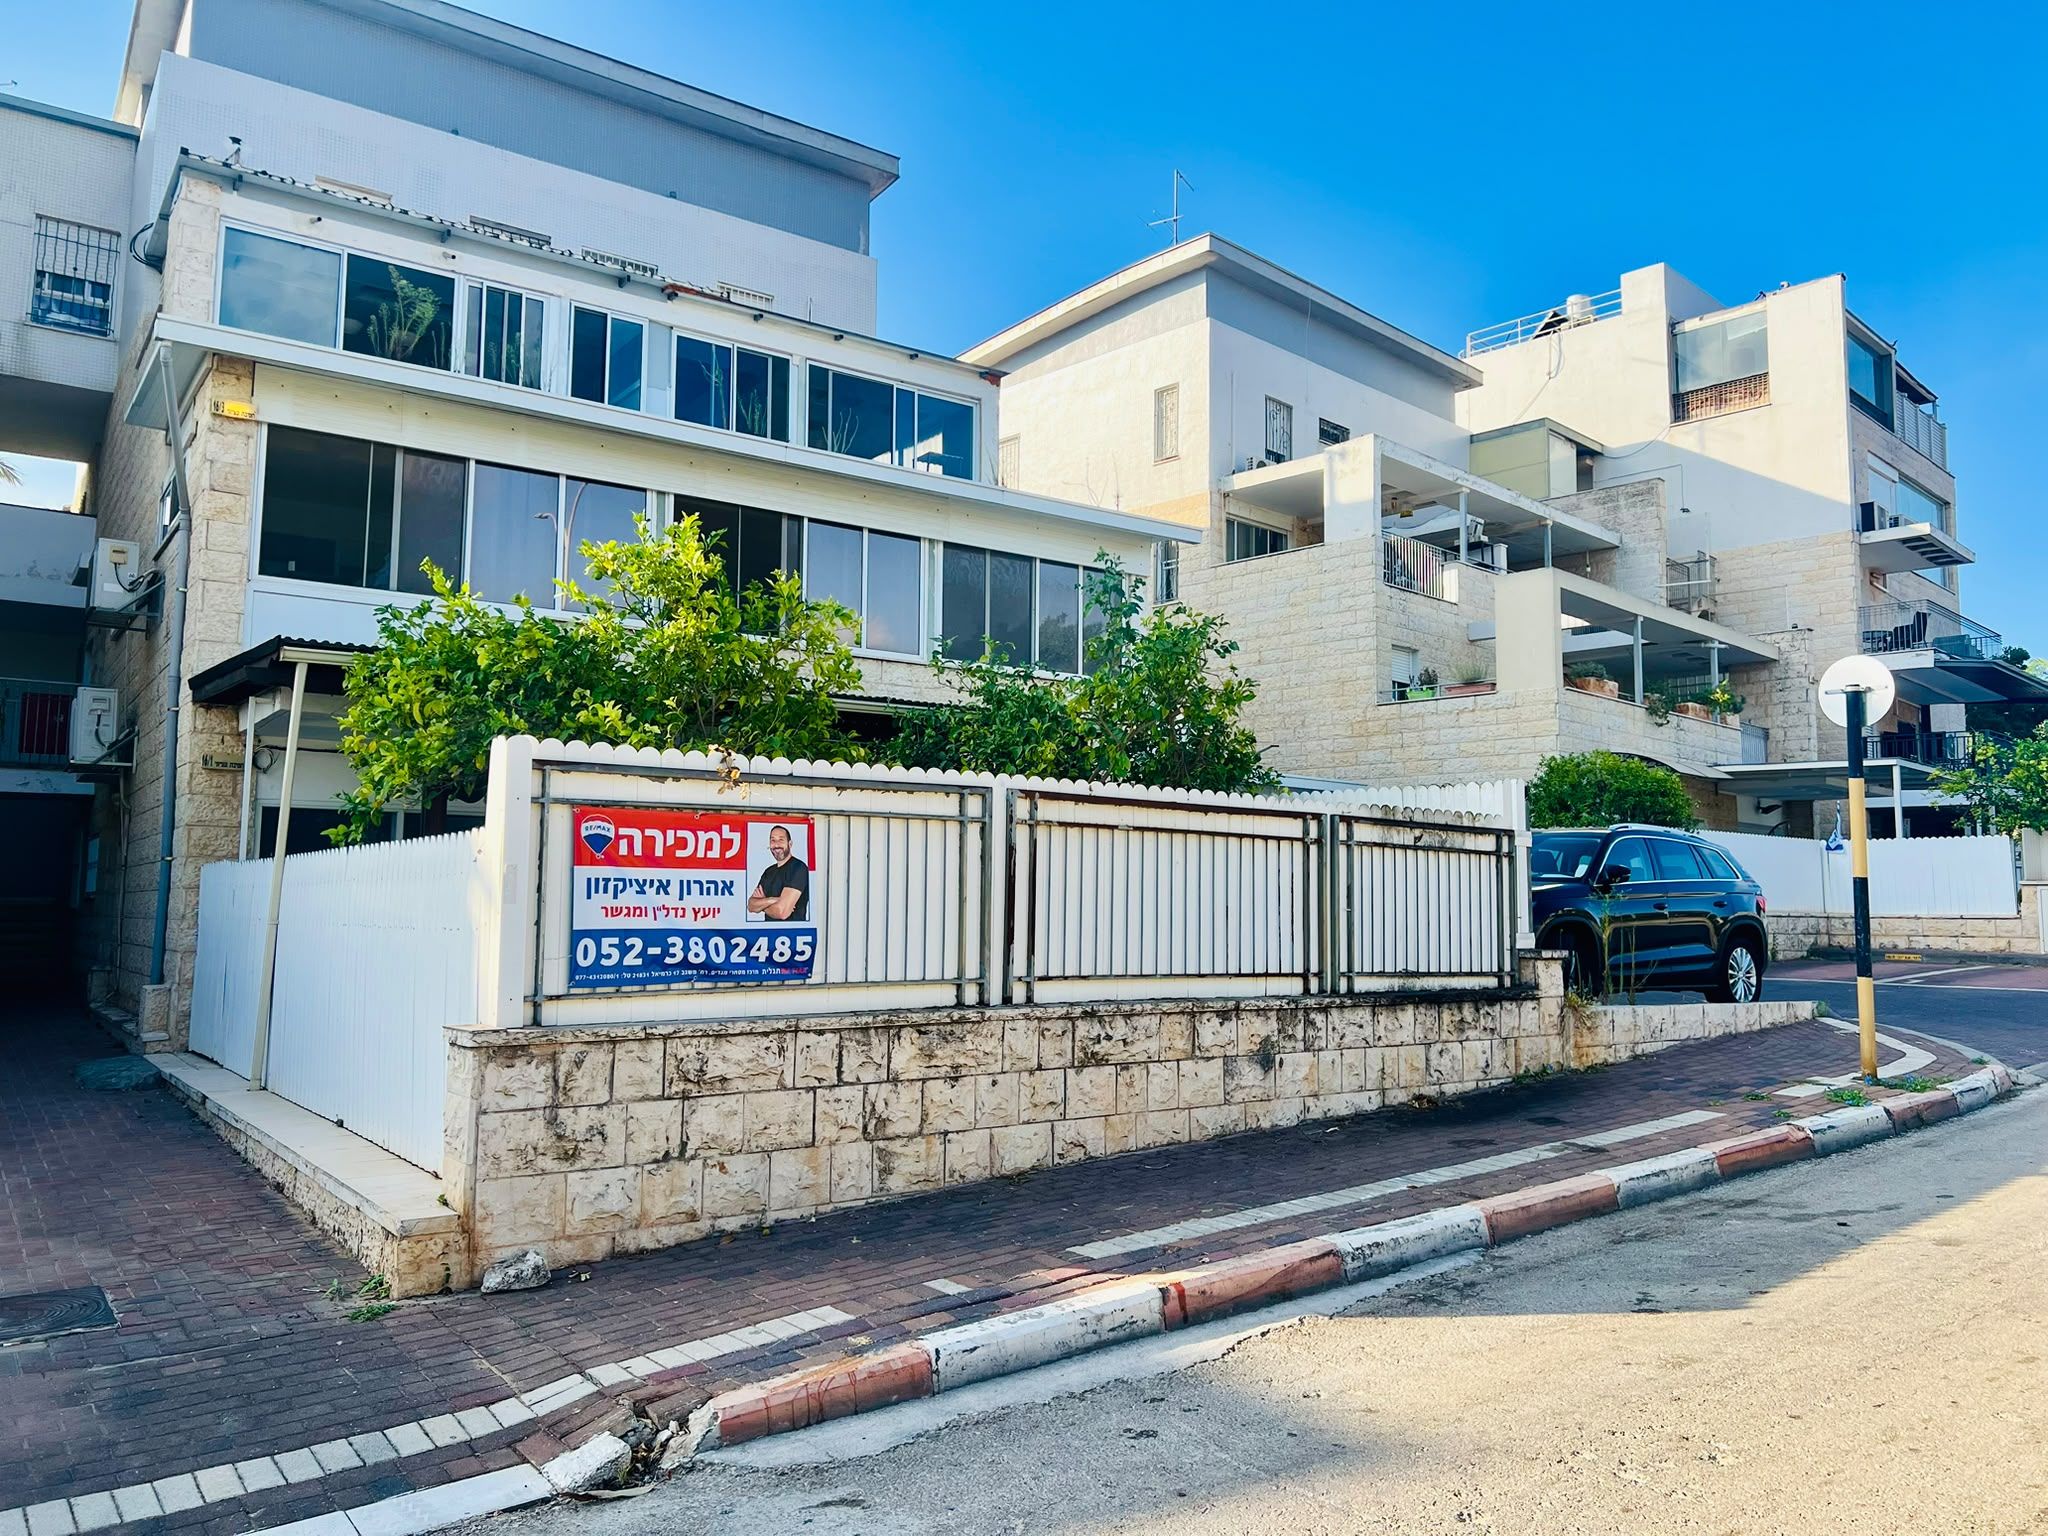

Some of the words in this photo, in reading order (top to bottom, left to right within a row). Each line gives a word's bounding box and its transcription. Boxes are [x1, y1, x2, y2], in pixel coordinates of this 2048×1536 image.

[584, 824, 611, 832] RE/MAX
[618, 823, 741, 859] למכירה
[586, 877, 671, 900] איציקזון
[678, 879, 735, 901] אהרון
[600, 905, 648, 918] ומגשר
[692, 907, 721, 921] יועץ
[576, 935, 813, 968] 052-3802485
